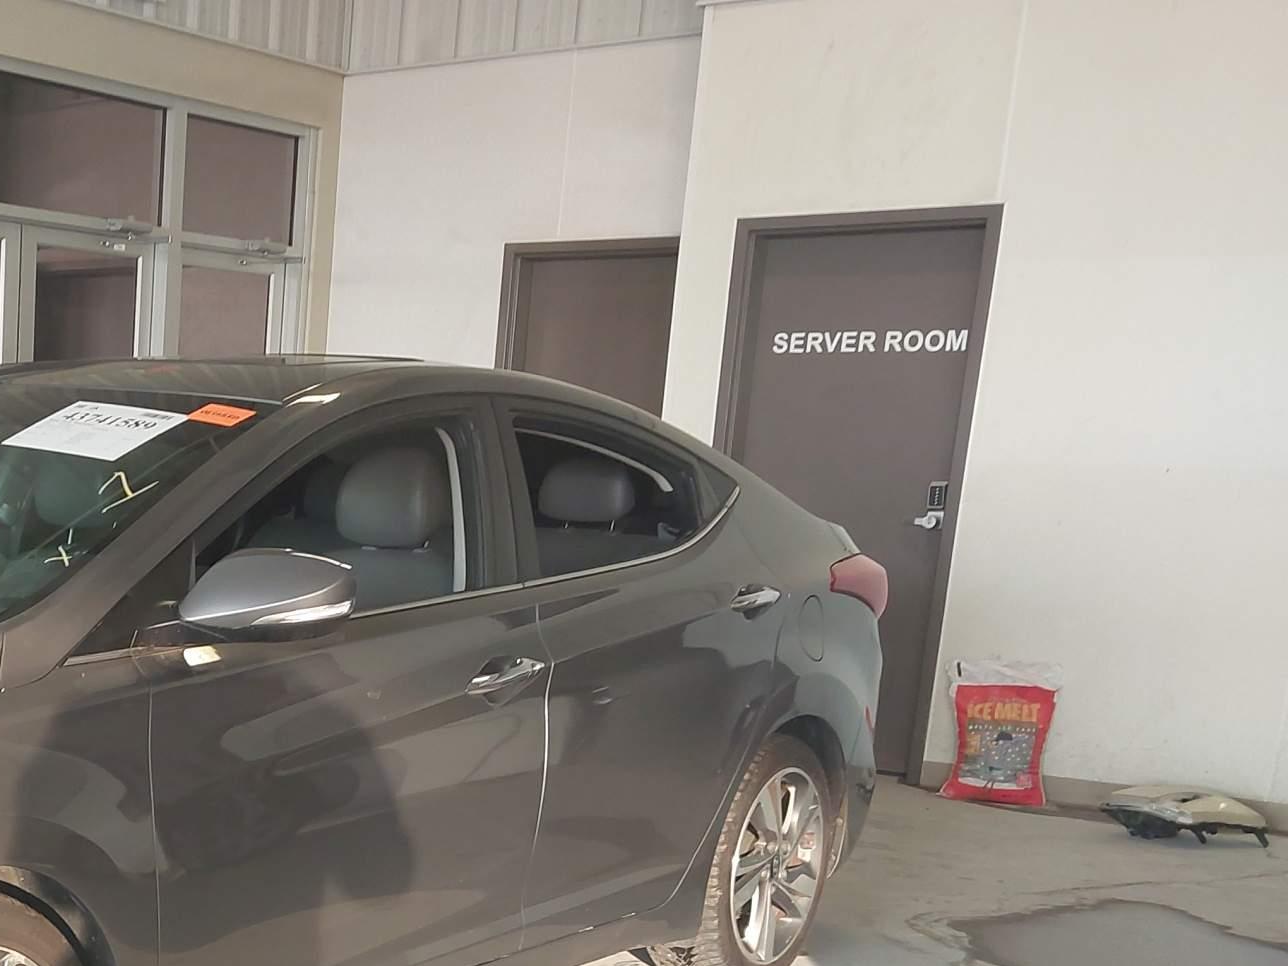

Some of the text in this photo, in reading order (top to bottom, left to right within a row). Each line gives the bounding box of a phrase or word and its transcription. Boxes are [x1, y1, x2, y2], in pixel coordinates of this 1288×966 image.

[772, 329, 969, 354] SERVER ROOM
[63, 411, 158, 430] 43741589
[967, 702, 1040, 722] ICE MELT
